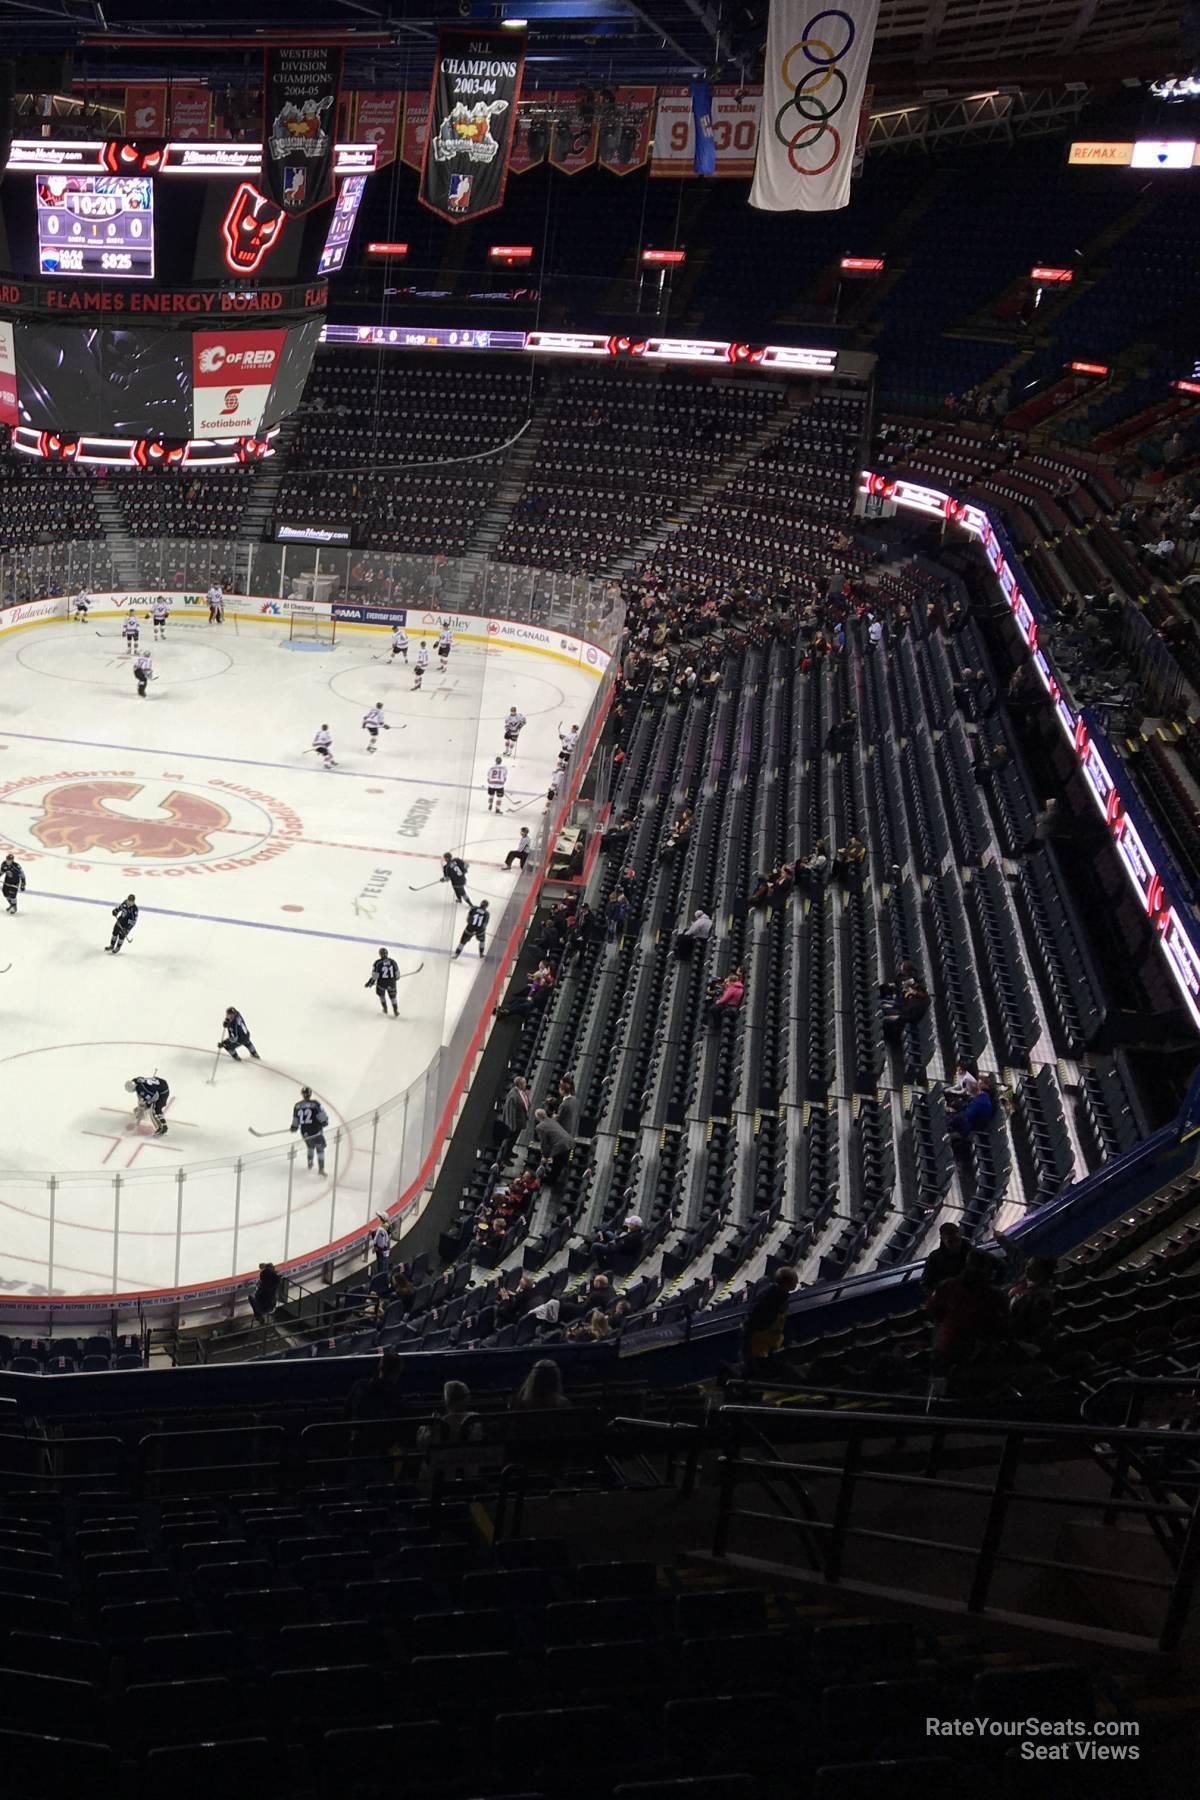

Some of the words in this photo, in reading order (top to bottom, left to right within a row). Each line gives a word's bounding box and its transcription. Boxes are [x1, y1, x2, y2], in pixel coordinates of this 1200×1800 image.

[280, 49, 328, 59] WESTERN
[469, 42, 492, 54] NLL
[281, 62, 327, 72] DIVISION
[440, 58, 517, 78] CHAMPIONS
[273, 74, 333, 84] CHAMPIONS
[454, 78, 496, 94] 2003-04
[284, 86, 319, 96] 2004-05
[718, 105, 756, 113] VERNON
[671, 122, 689, 151] 9
[712, 120, 756, 150] 30
[72, 196, 116, 214] 10:20
[47, 215, 60, 235] 0
[72, 223, 82, 235] 0
[108, 223, 116, 236] 0
[130, 218, 143, 238] 0
[47, 289, 124, 311] FLAMES
[130, 293, 215, 313] ENERGY
[221, 291, 283, 311] BOARD
[226, 353, 243, 364] OF
[243, 350, 276, 364] RED
[200, 418, 253, 429] Scotiabank
[278, 526, 349, 541] HitmenHockey.com
[10, 604, 58, 624] Budweiser
[340, 609, 361, 619] AMA
[501, 625, 516, 636] AIR
[516, 628, 550, 644] CANADA
[207, 778, 305, 837] Saddledome
[121, 841, 294, 878] Scotiabank
[361, 868, 392, 905] TELUS
[472, 914, 484, 927] 11
[381, 965, 395, 978] 21
